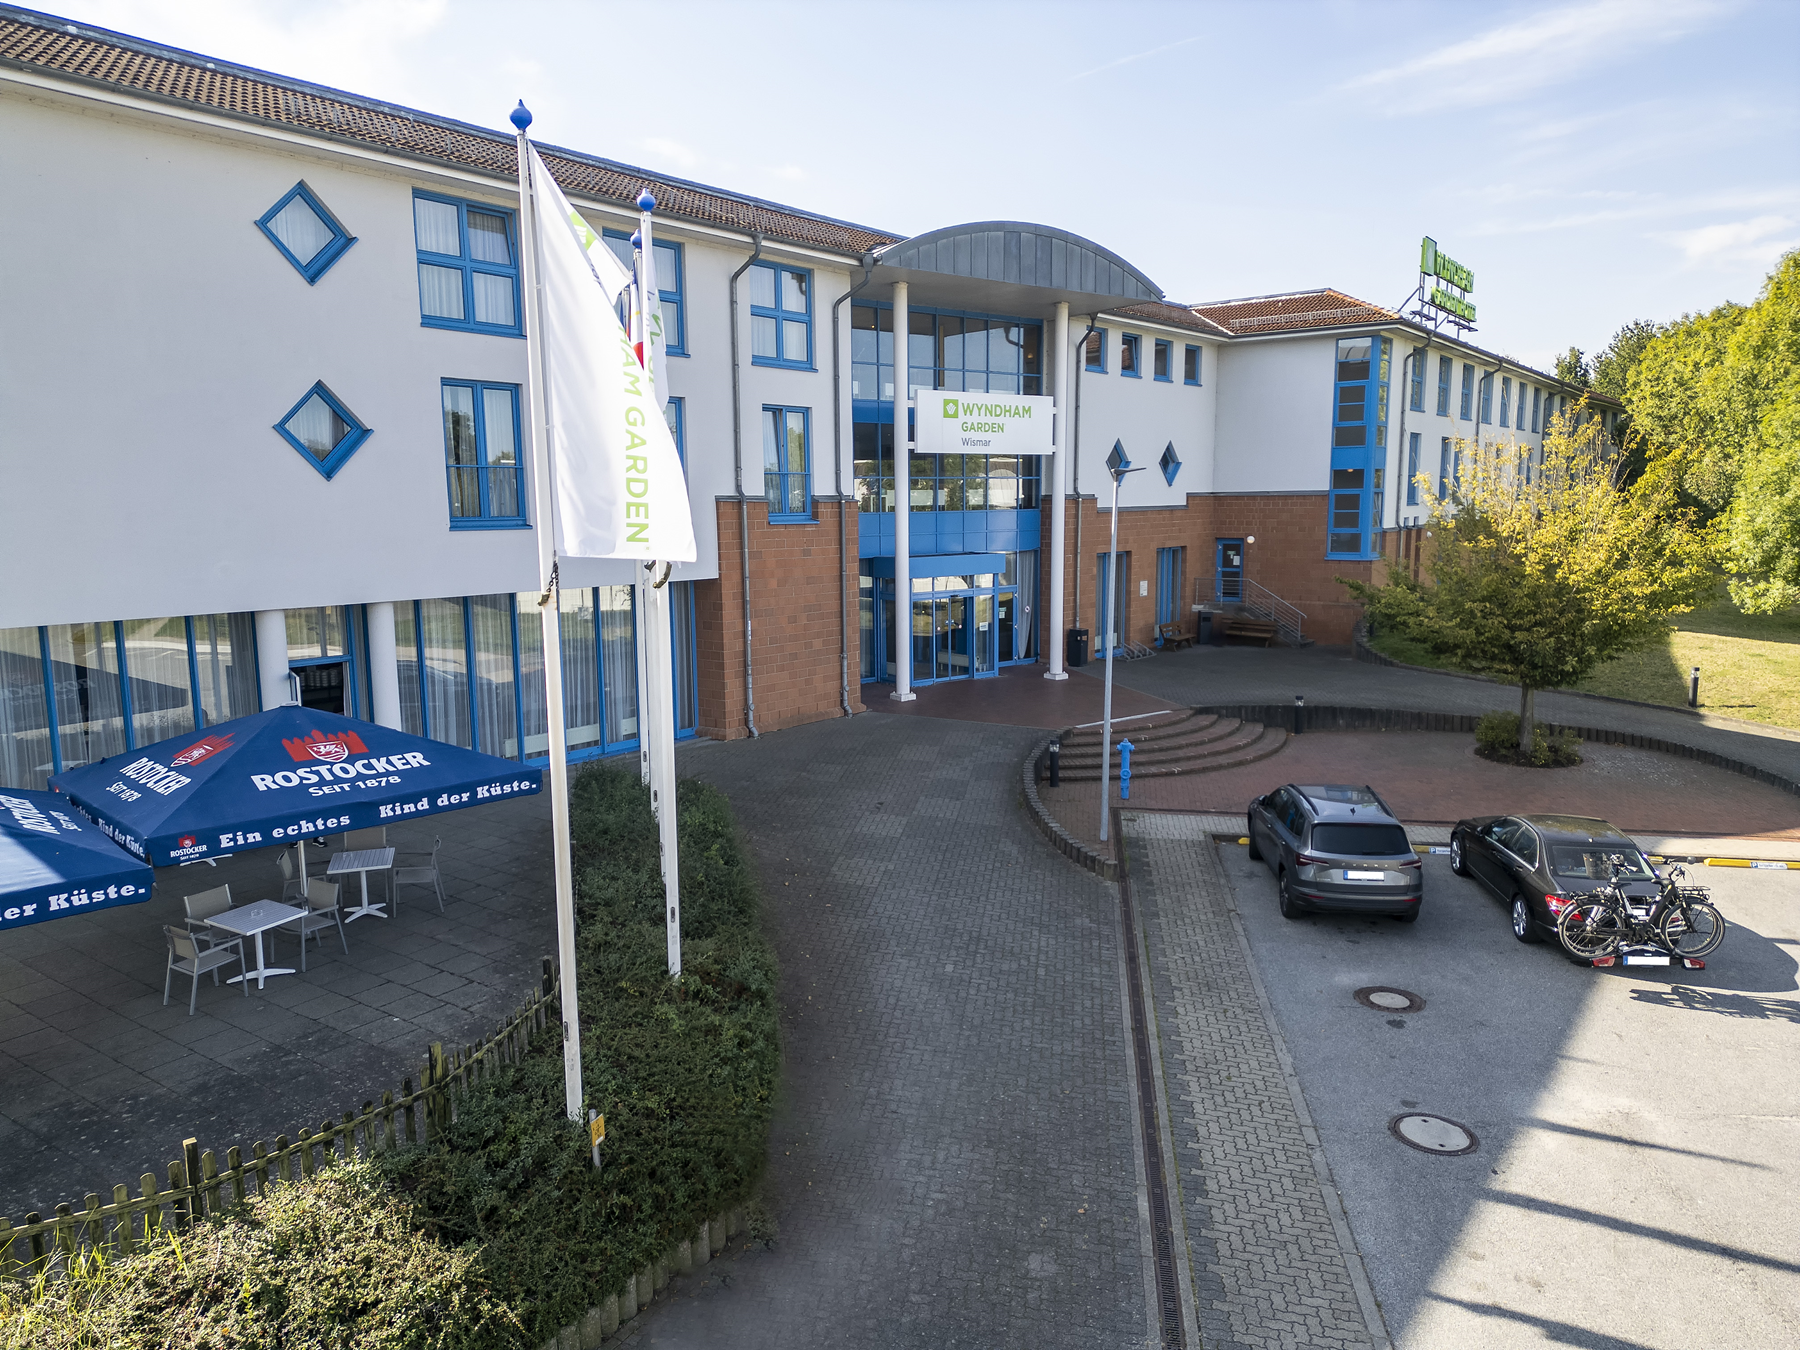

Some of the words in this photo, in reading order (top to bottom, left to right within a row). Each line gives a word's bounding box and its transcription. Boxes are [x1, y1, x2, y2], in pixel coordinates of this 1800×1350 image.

[961, 402, 1032, 418] WYNDHAM
[961, 421, 1005, 433] GARDEN
[961, 437, 991, 447] Wismar
[624, 406, 650, 543] GARDEN
[119, 757, 192, 796] ROSTOCKER
[250, 751, 431, 792] ROSTOCKER
[308, 783, 352, 797] SEIT
[354, 775, 402, 789] 1878
[219, 831, 263, 848] Ein
[272, 815, 351, 839] echtes
[378, 797, 430, 818] Kind
[436, 793, 470, 807] der
[476, 779, 537, 799] Küste.
[170, 844, 208, 858] ROSTOCKER
[0, 902, 37, 921] er
[48, 883, 146, 912] Küste.
